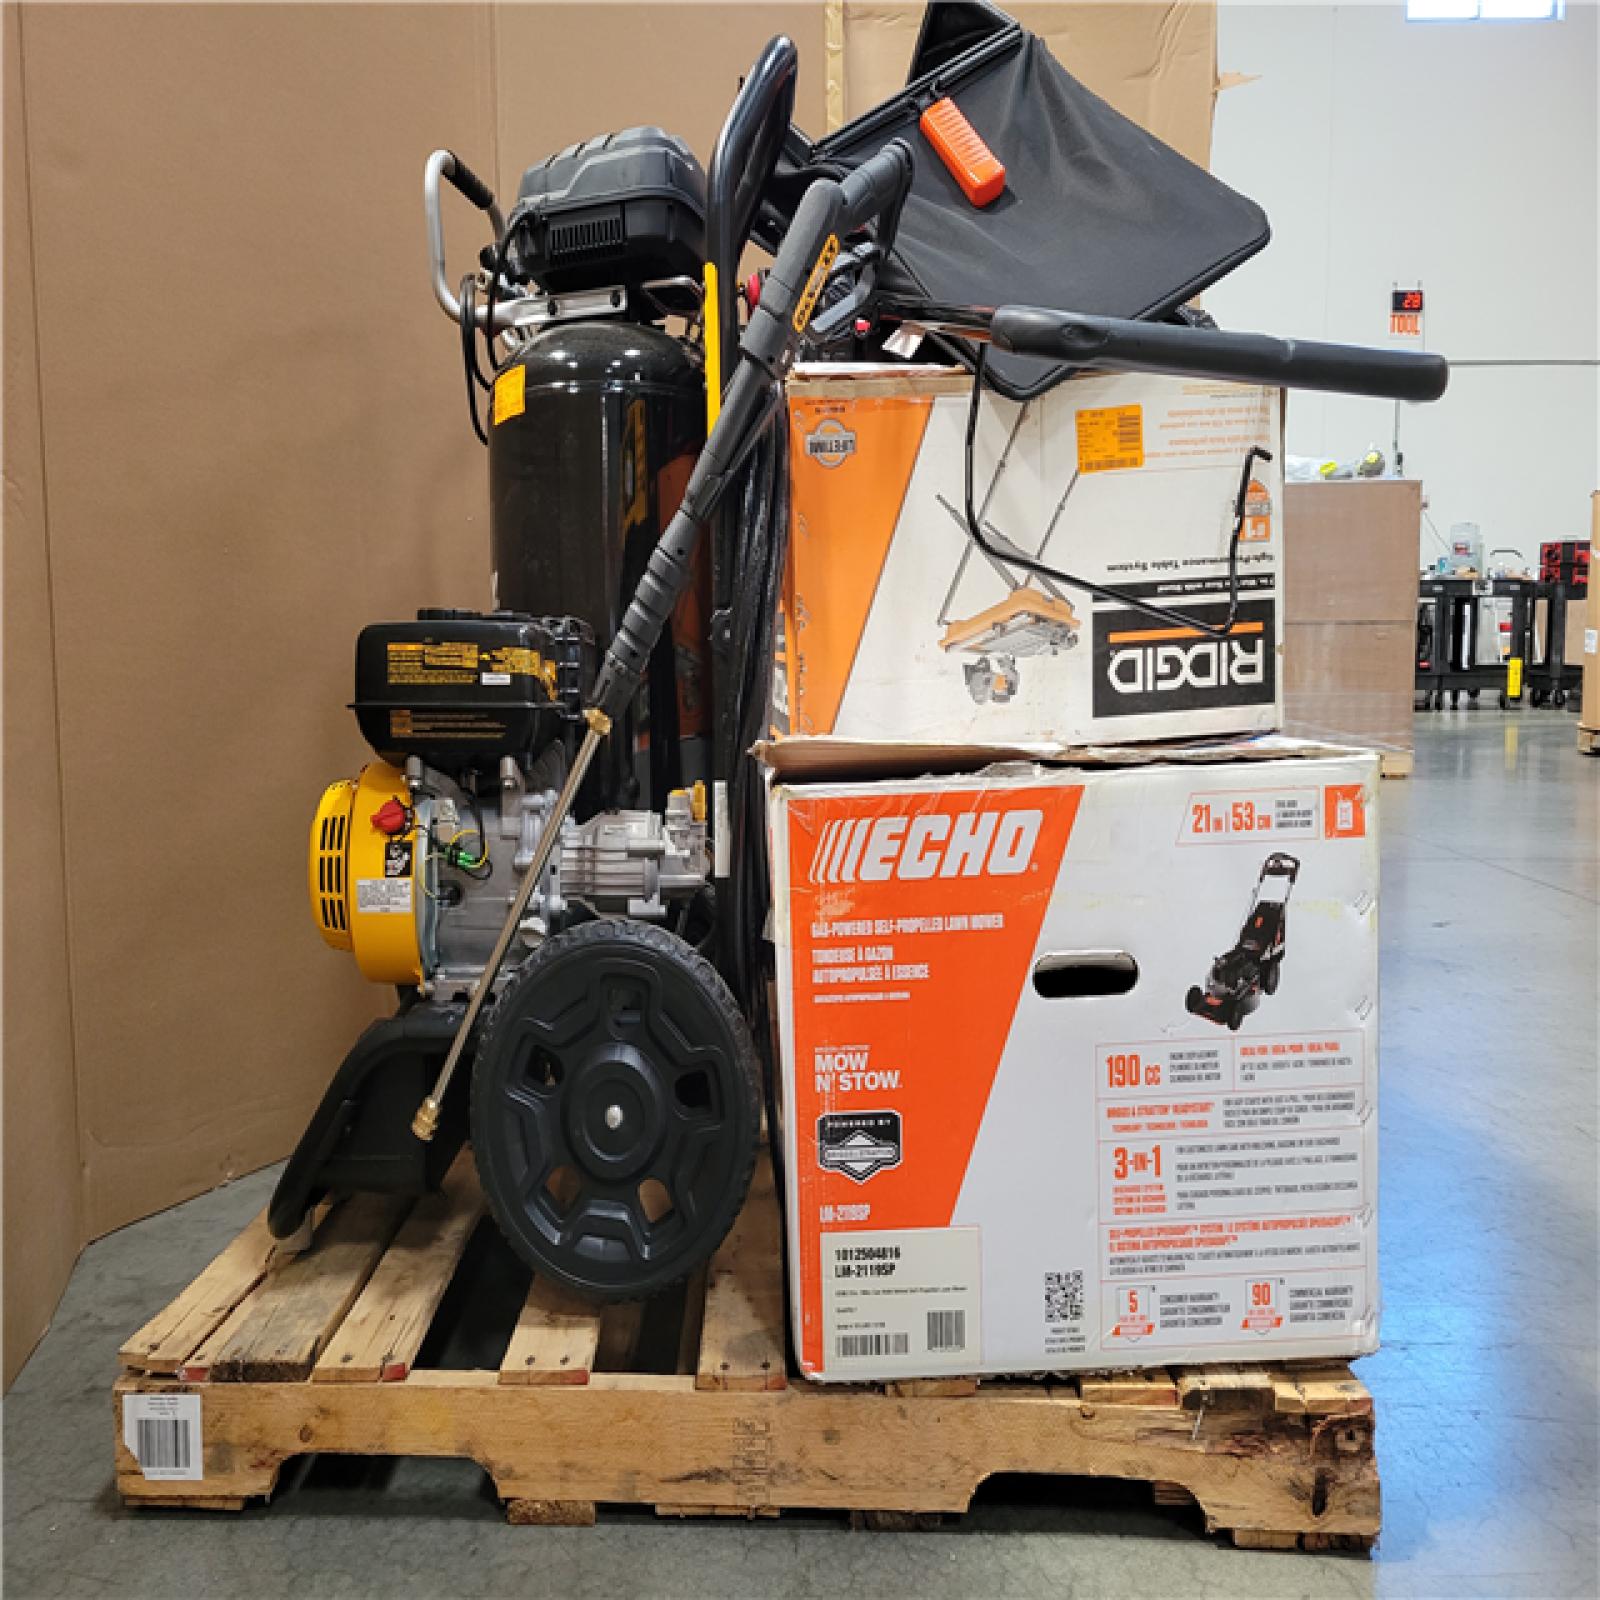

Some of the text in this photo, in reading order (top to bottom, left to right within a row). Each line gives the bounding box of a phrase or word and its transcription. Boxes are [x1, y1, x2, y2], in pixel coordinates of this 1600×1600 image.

[1107, 638, 1264, 693] RIDGID
[1192, 803, 1211, 833] 21
[1231, 800, 1255, 831] 53
[859, 810, 1043, 880] ECHO
[815, 1053, 868, 1070] MOW
[1106, 1053, 1140, 1088] 190
[1112, 1144, 1161, 1180] 3-IN-1
[1127, 1289, 1138, 1313] 5
[1251, 1282, 1271, 1306] 90
